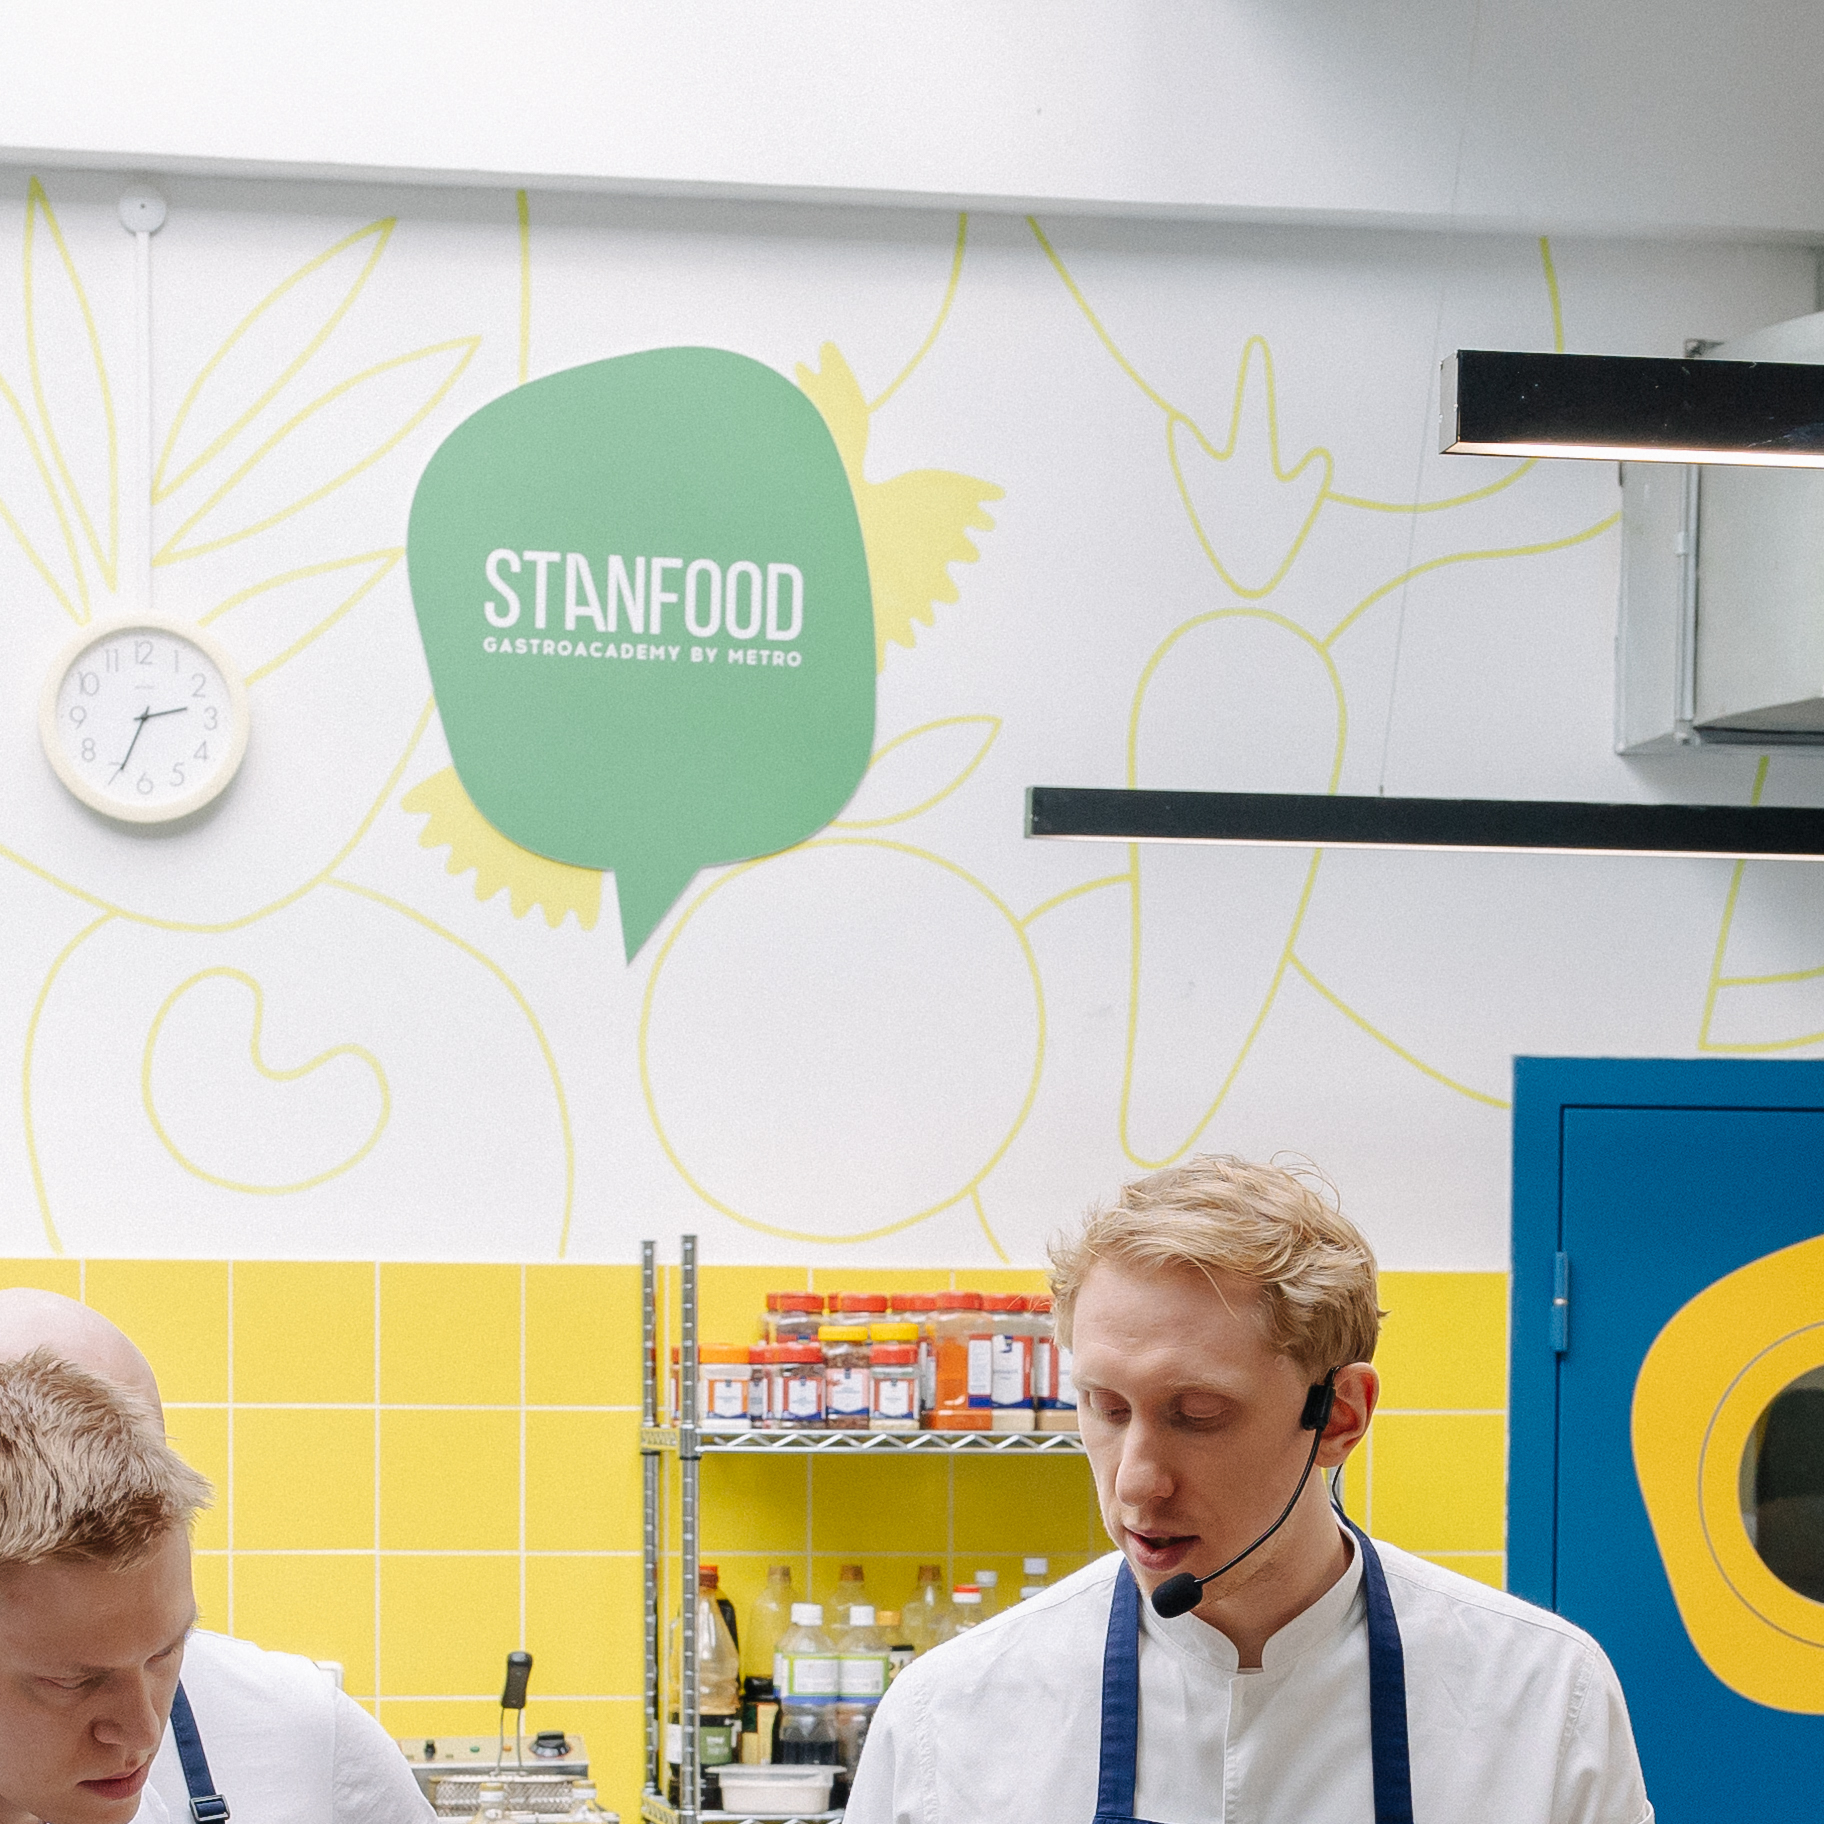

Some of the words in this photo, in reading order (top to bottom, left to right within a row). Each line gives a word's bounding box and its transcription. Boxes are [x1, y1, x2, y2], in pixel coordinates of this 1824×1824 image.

[483, 548, 804, 641] STANFOOD
[106, 649, 119, 672] 11
[134, 640, 155, 665] 12
[173, 650, 180, 673] 1
[483, 636, 681, 663] GASTROACADEMY
[690, 646, 719, 664] BY
[728, 648, 803, 667] METRO
[78, 671, 101, 697] 10
[191, 673, 207, 698] 2
[69, 705, 88, 730] 9
[204, 706, 219, 731] 3
[81, 737, 96, 763] 8
[193, 740, 209, 762] 4
[136, 772, 155, 796] 6
[169, 762, 186, 787] 5
